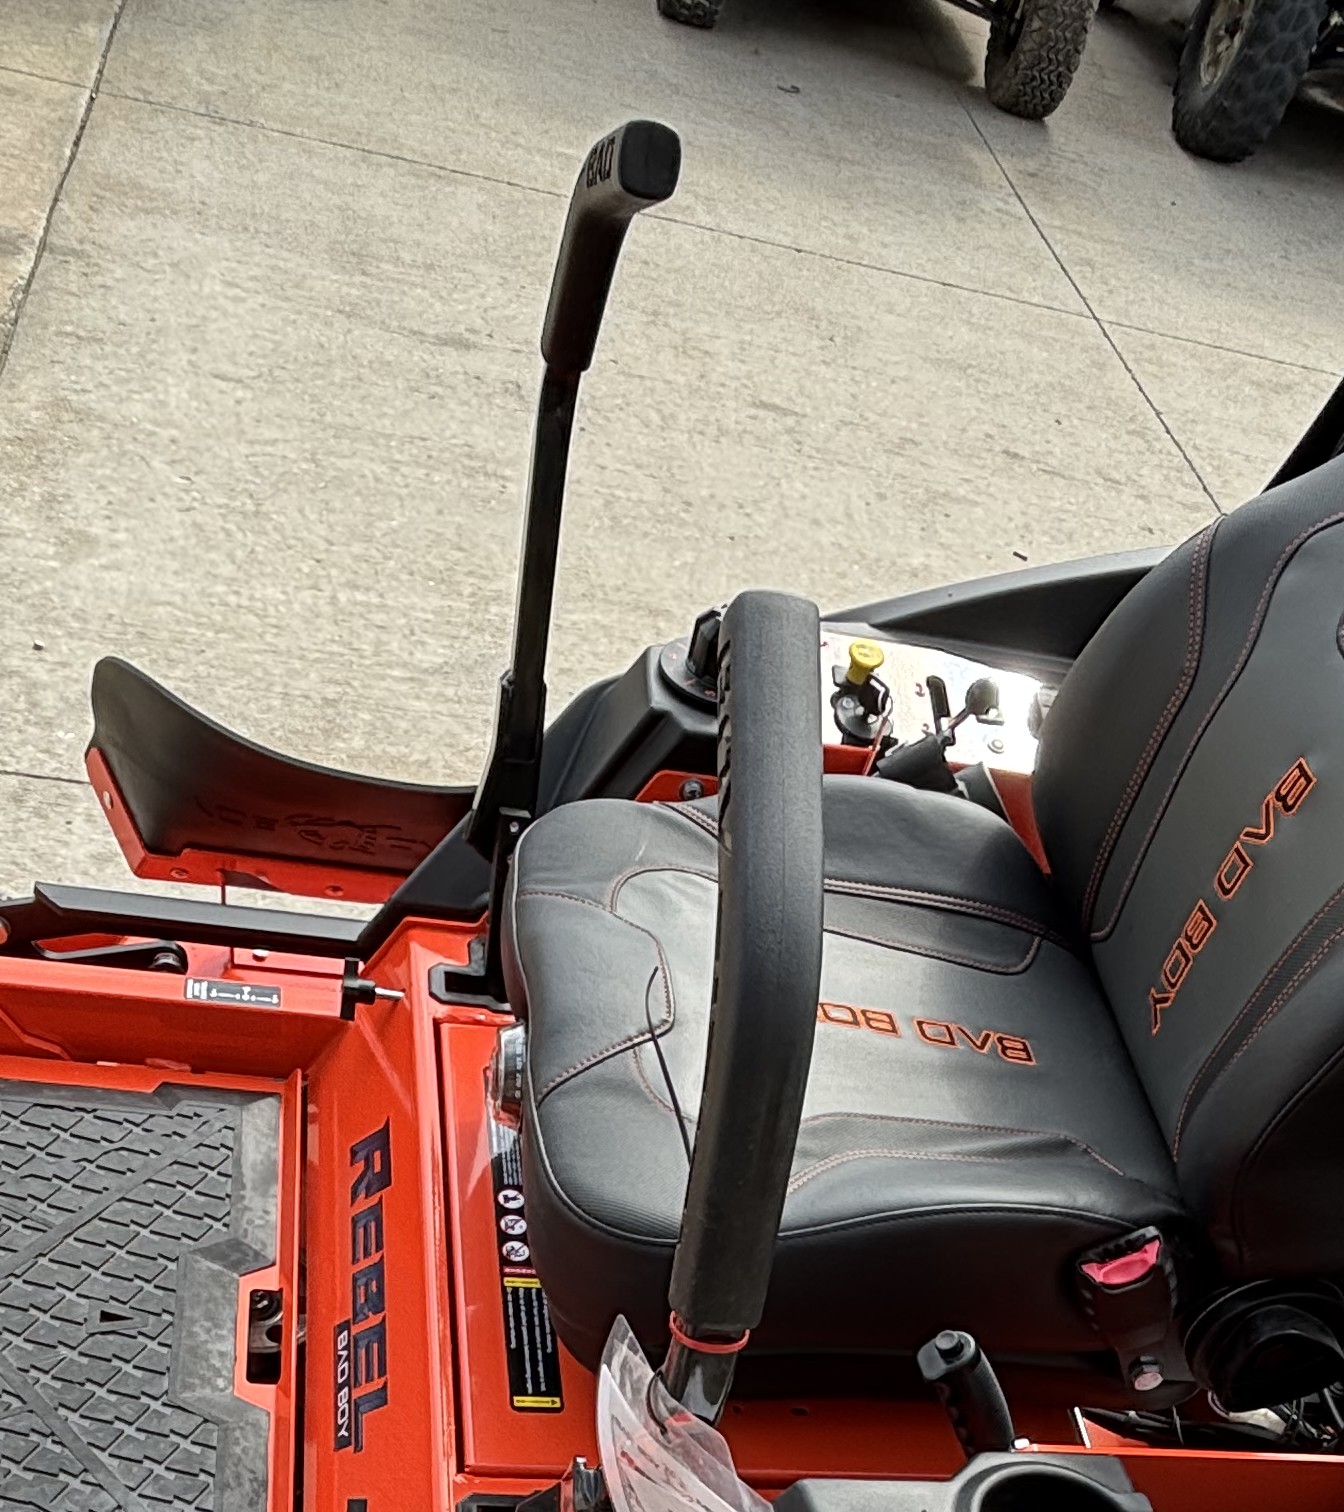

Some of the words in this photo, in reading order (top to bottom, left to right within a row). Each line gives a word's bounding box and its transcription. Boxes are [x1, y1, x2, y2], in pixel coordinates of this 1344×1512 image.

[1213, 757, 1318, 900] BAD
[1149, 898, 1217, 1036] BOY
[817, 1001, 902, 1038] BO
[912, 1017, 1037, 1065] BAD
[350, 1116, 391, 1453] REBEL
[338, 1329, 349, 1384] BAD
[338, 1386, 349, 1438] BOY
